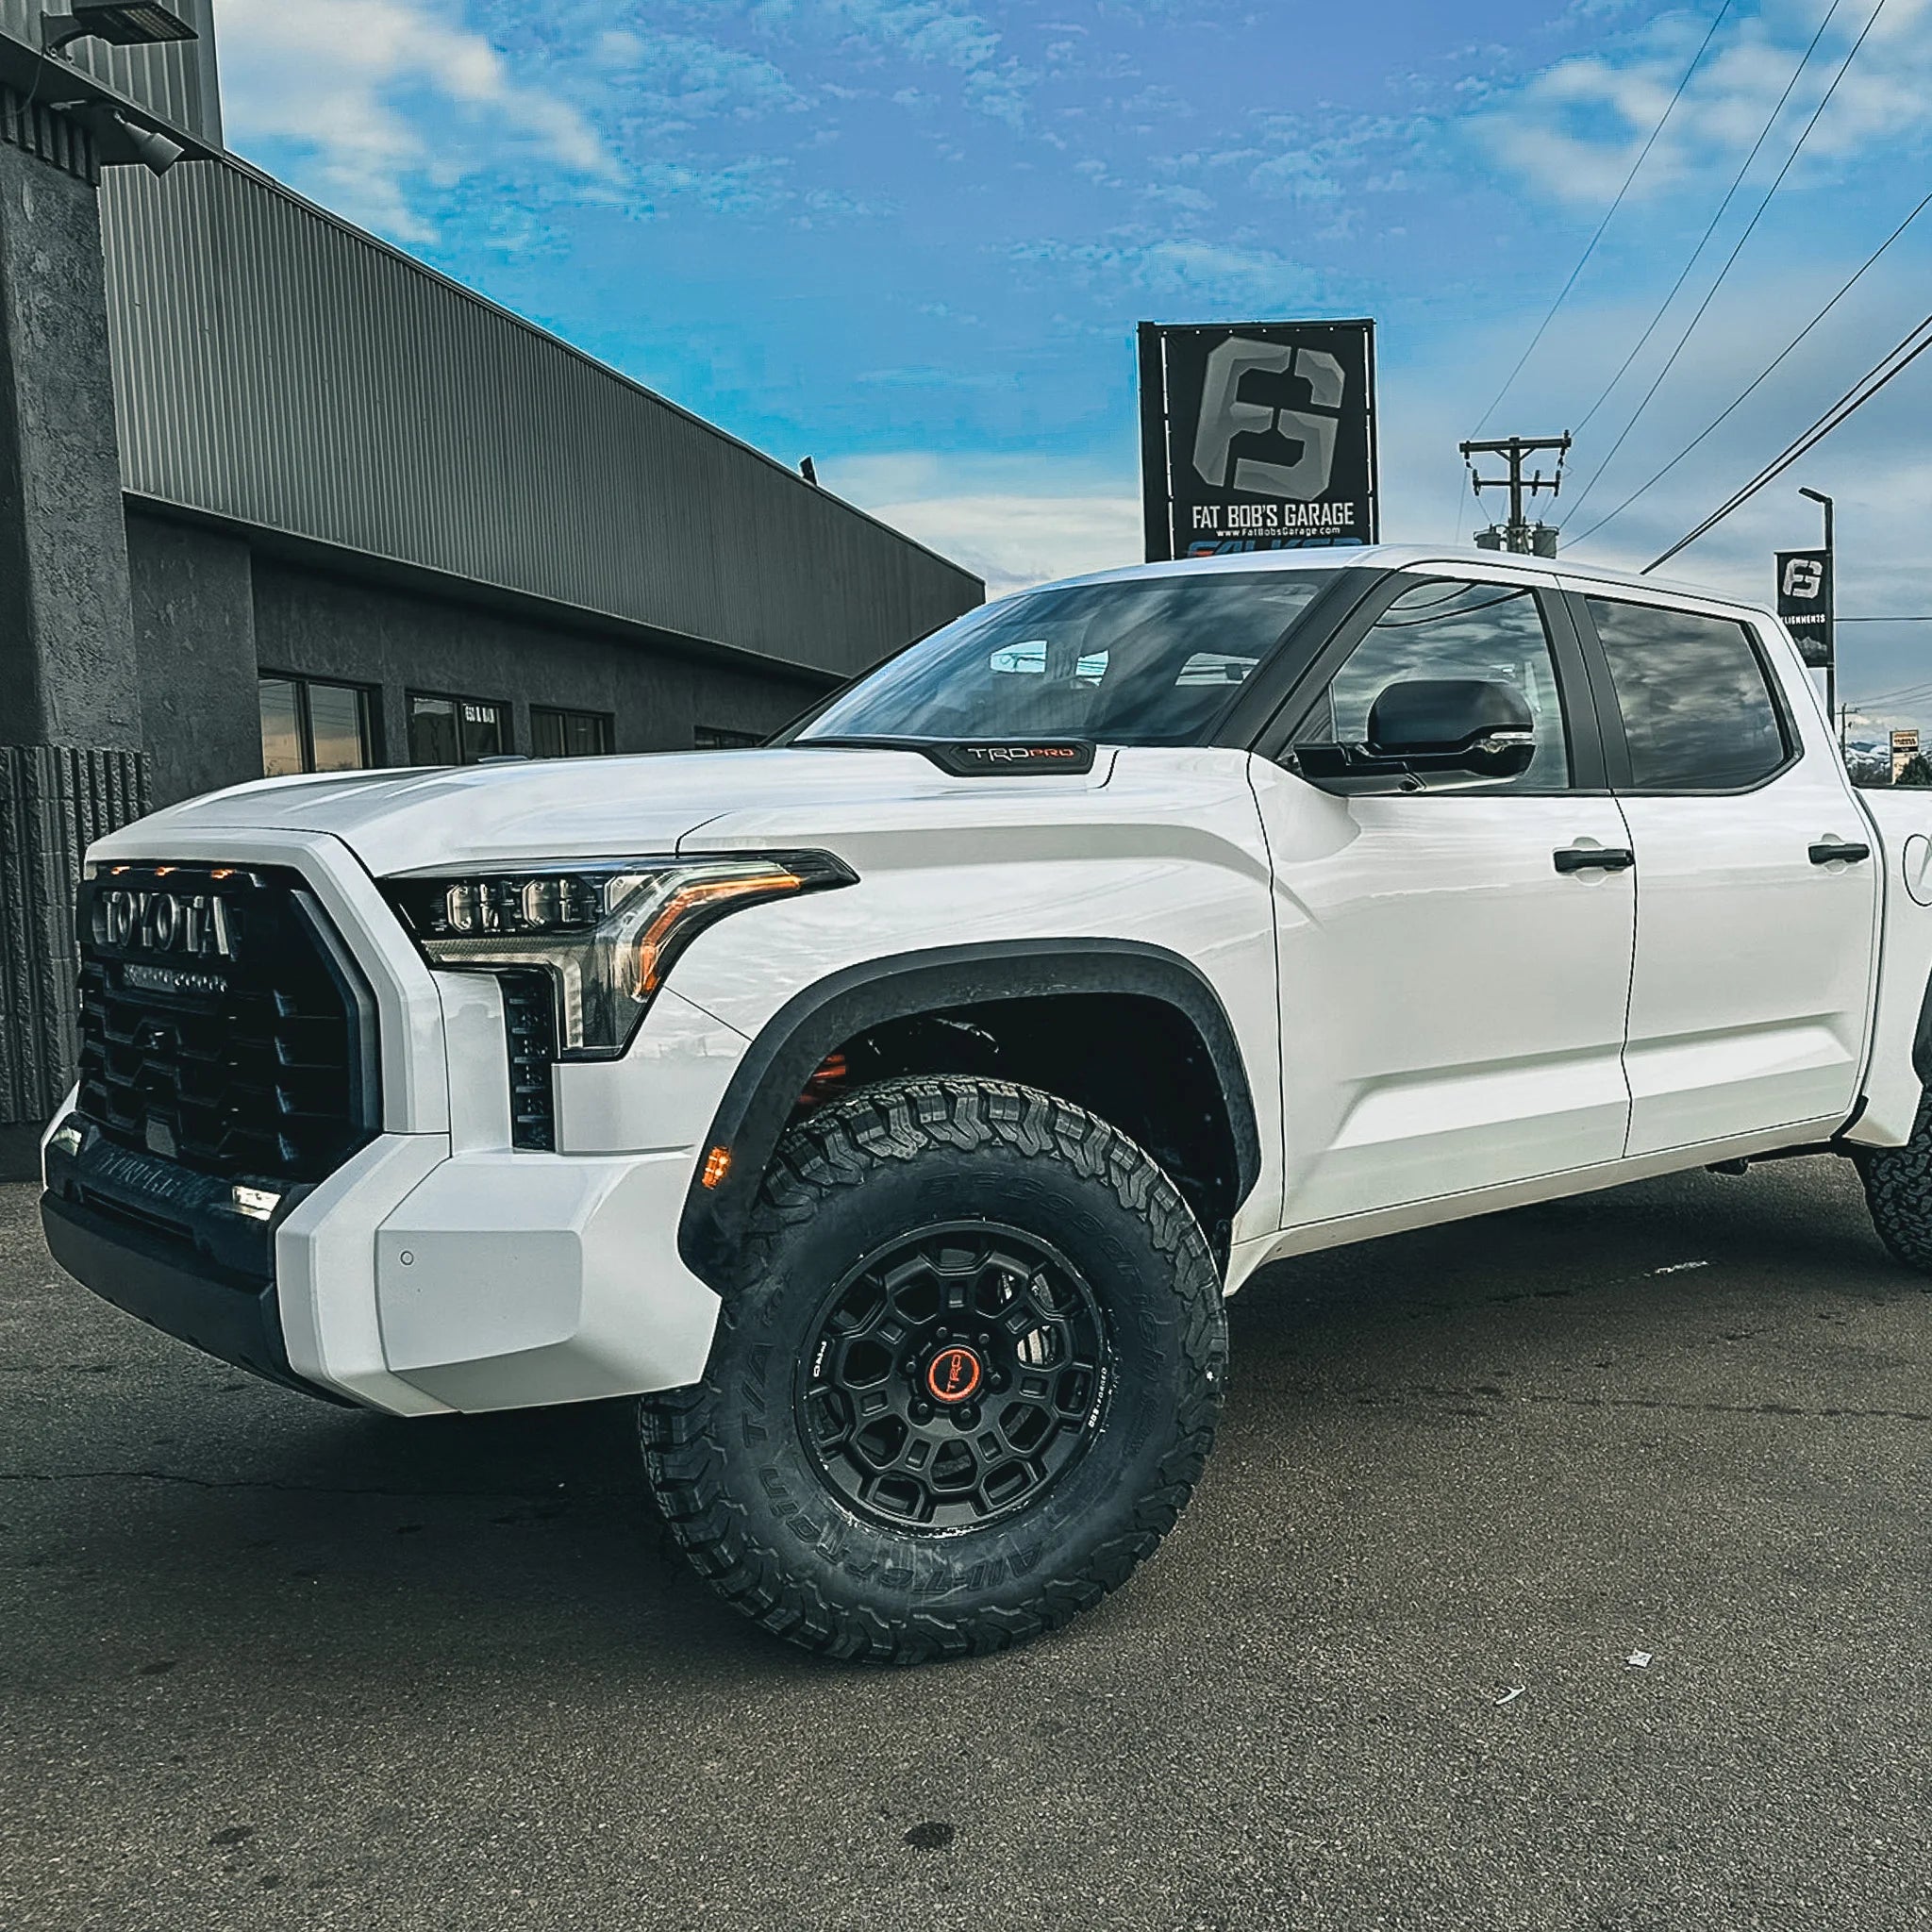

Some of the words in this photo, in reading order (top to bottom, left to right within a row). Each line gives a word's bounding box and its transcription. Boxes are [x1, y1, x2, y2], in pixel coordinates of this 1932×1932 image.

[1192, 506, 1221, 529] FAT
[1228, 504, 1277, 527] BOB'S
[1284, 502, 1355, 526] GARAGE
[102, 891, 232, 958] TOYOTA
[945, 1354, 963, 1392] TRD
